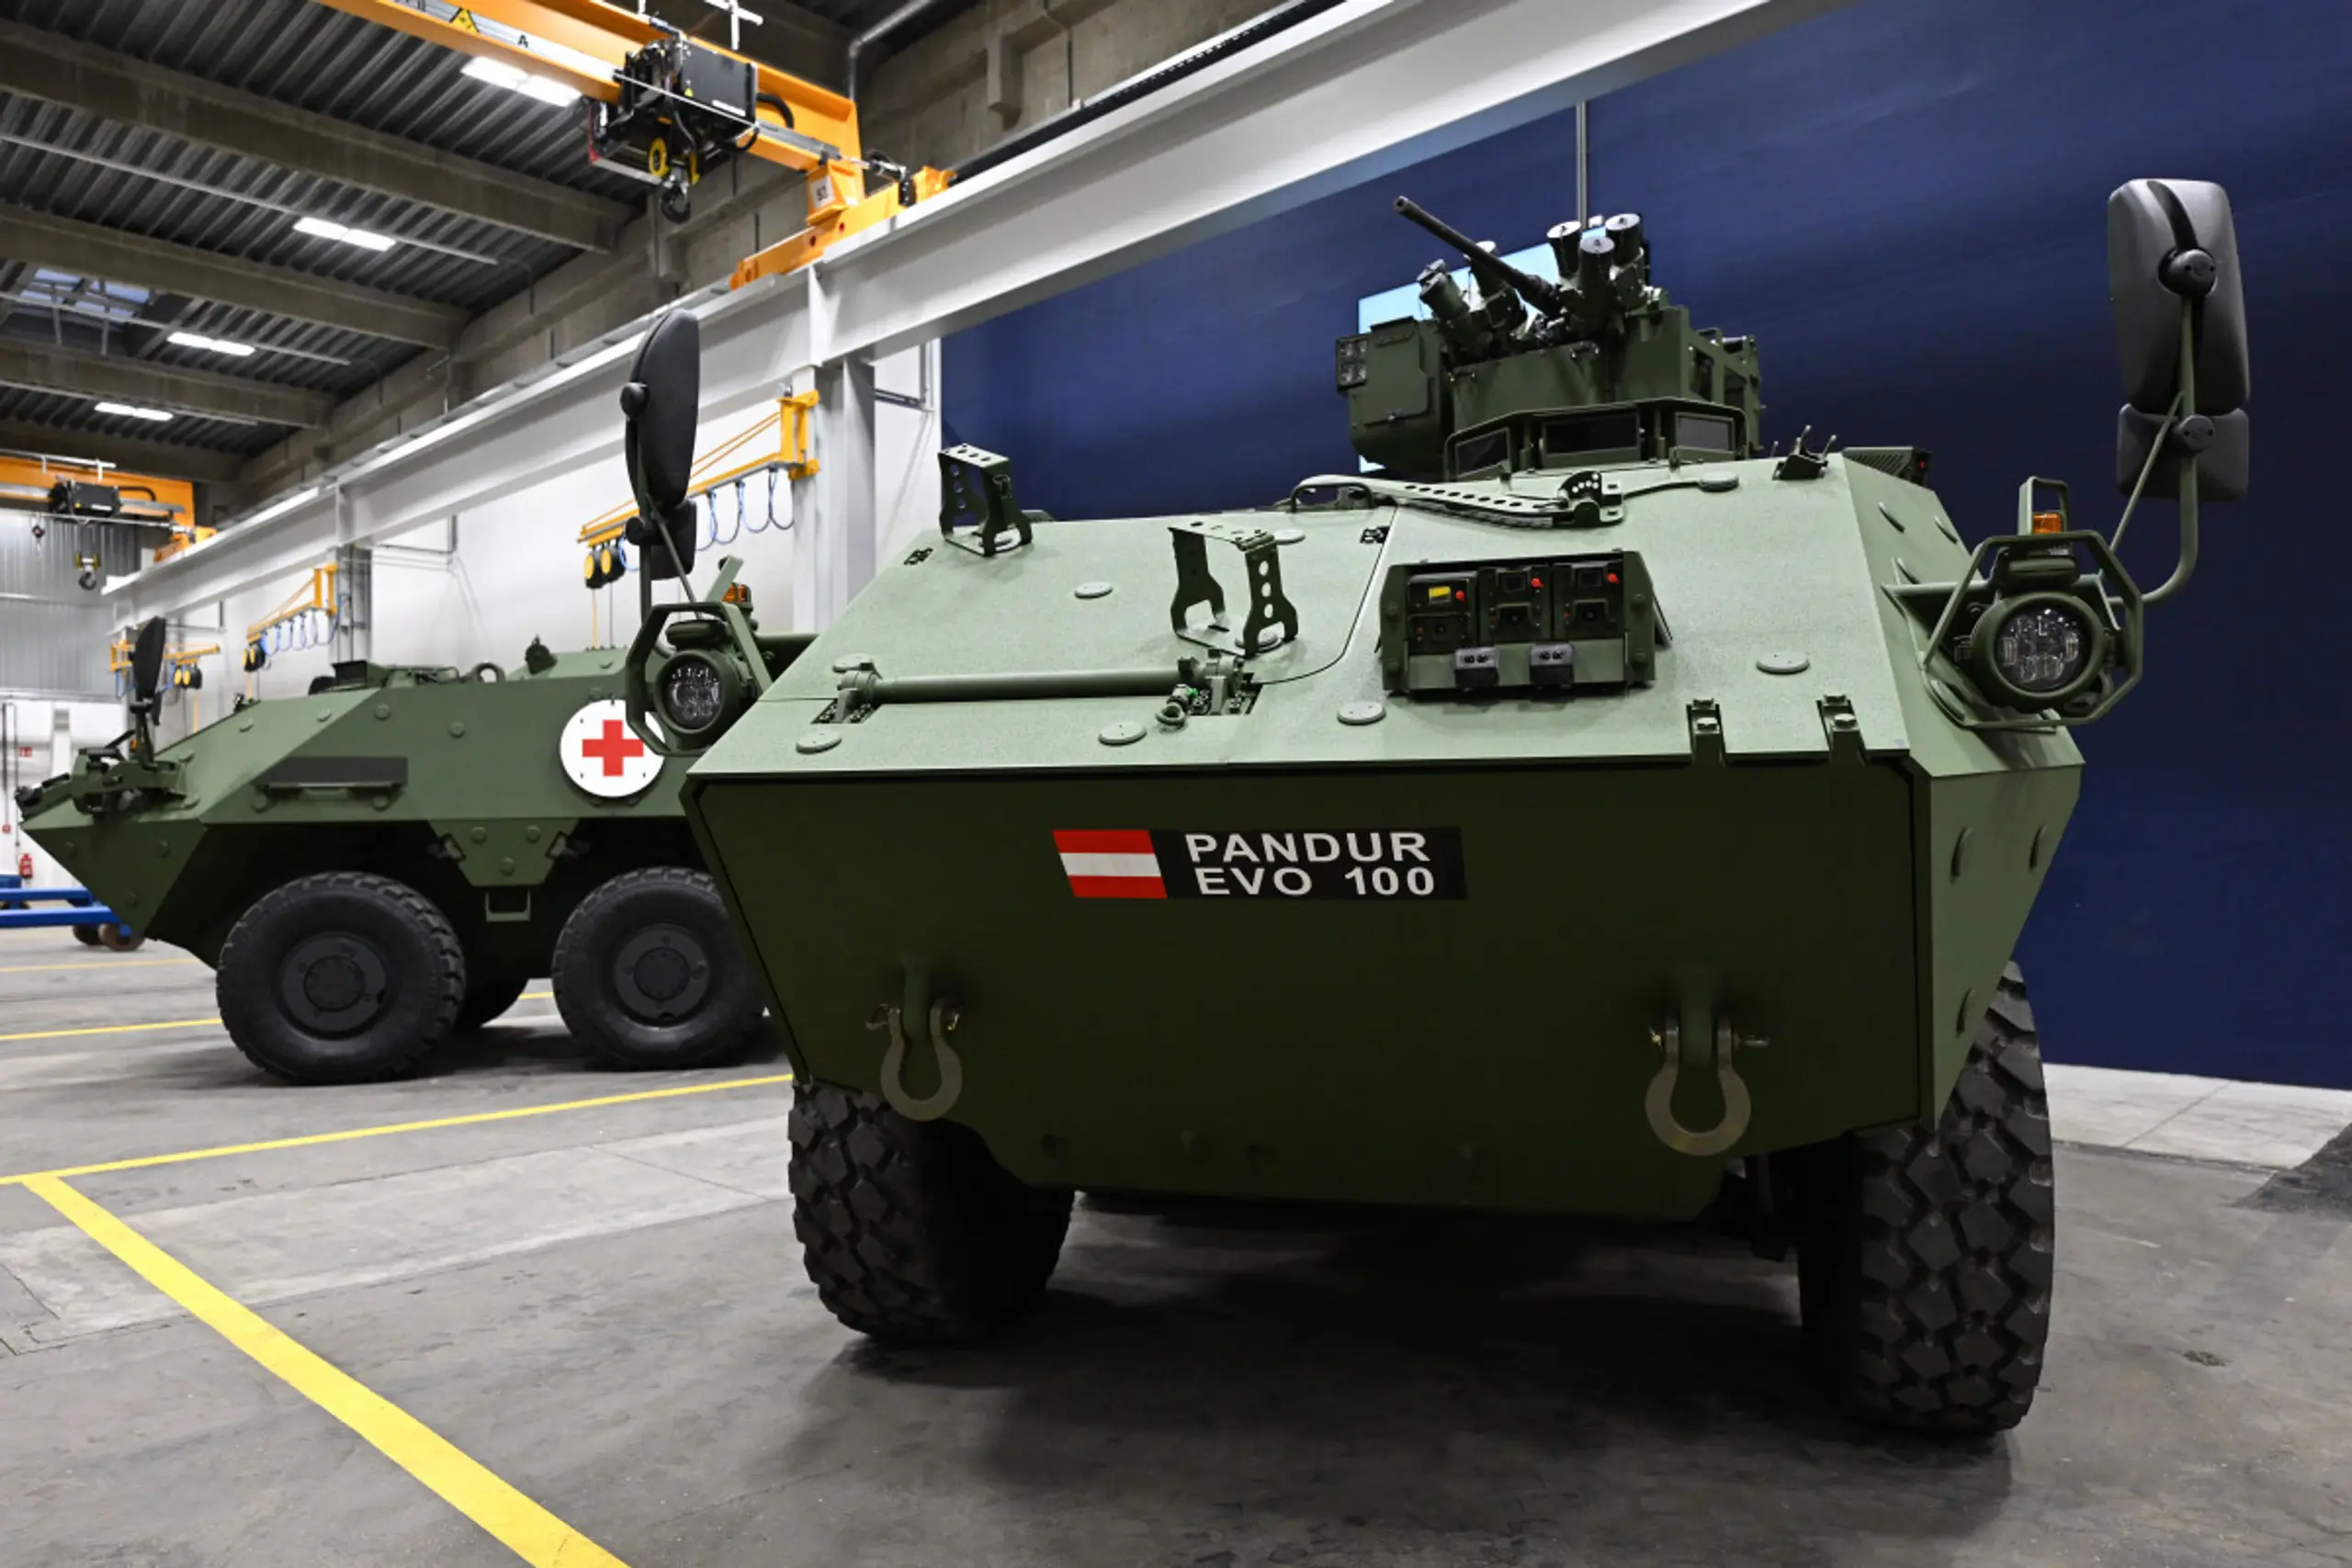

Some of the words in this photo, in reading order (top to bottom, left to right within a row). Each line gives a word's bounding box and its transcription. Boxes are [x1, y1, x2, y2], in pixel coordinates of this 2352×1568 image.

[1185, 832, 1430, 863] PANDUR
[1194, 866, 1312, 896] EVO
[1344, 866, 1434, 896] 100
